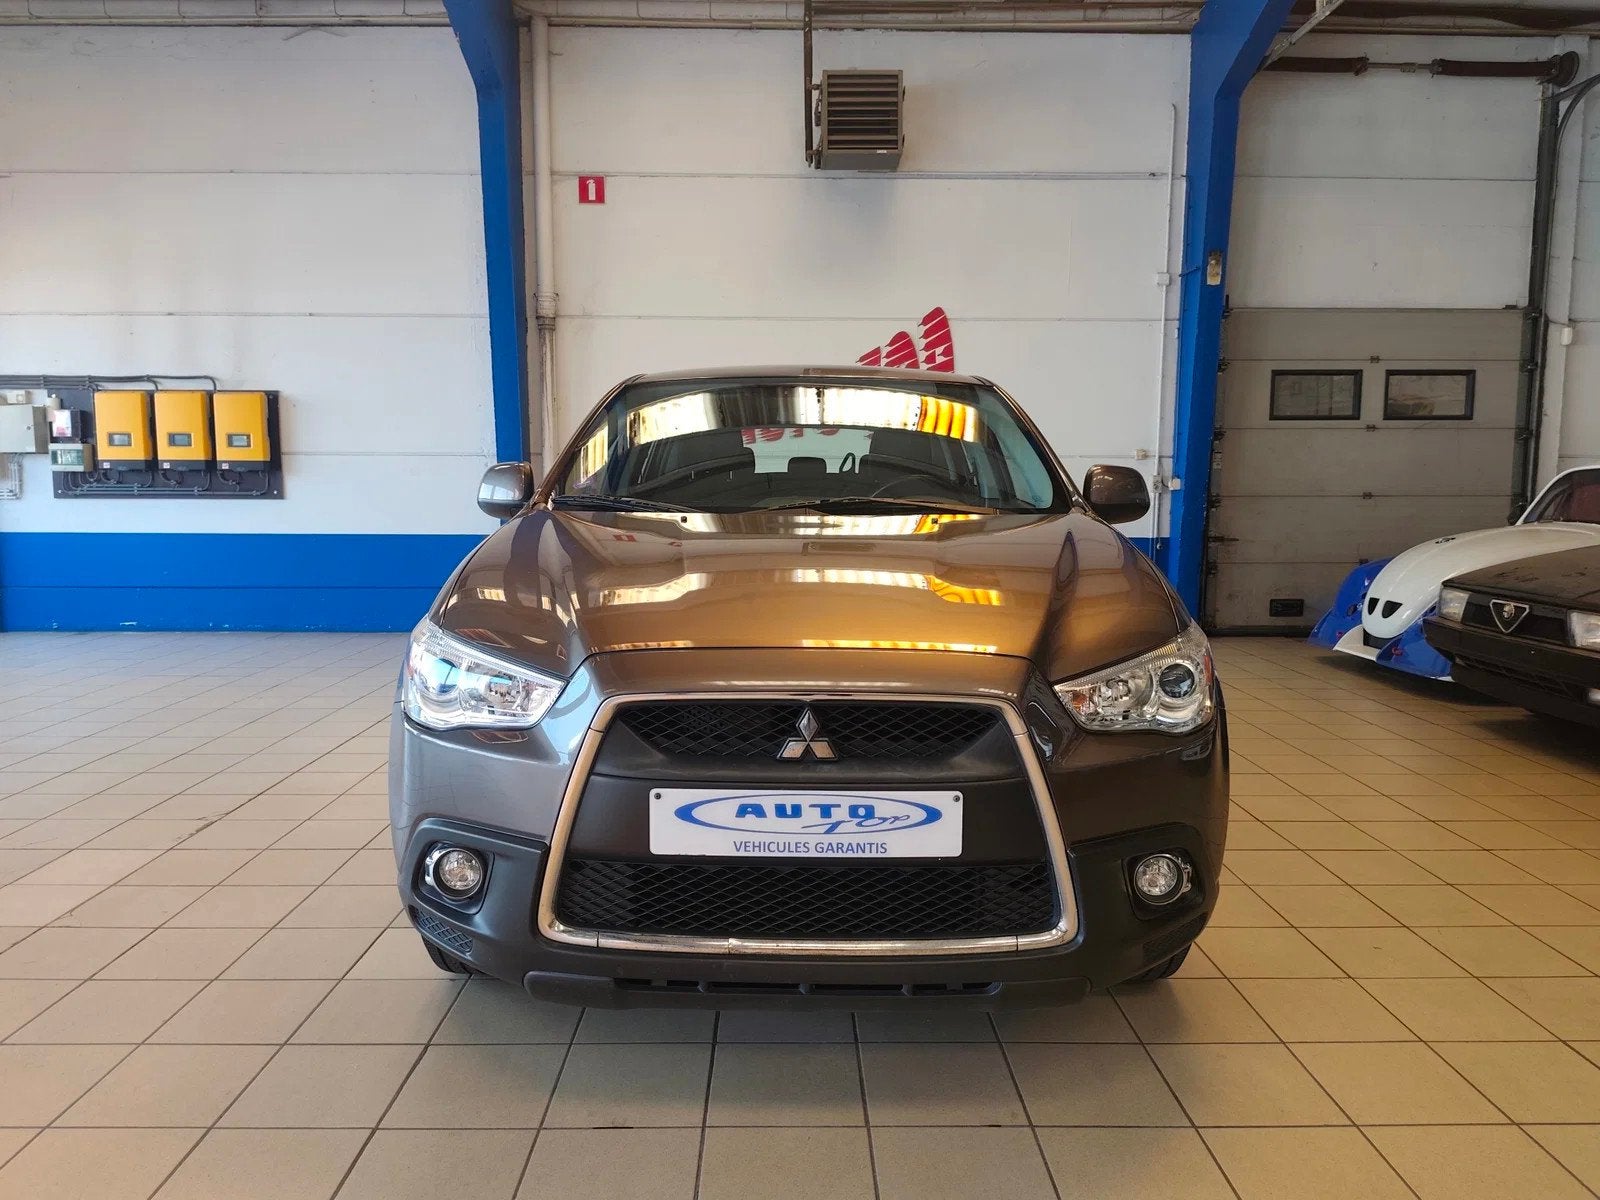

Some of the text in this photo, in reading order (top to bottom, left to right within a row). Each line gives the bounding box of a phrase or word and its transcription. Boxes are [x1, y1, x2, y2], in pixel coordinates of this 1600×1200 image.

[735, 803, 876, 819] AUTO
[733, 840, 888, 854] VEHICULES GARANTIS
